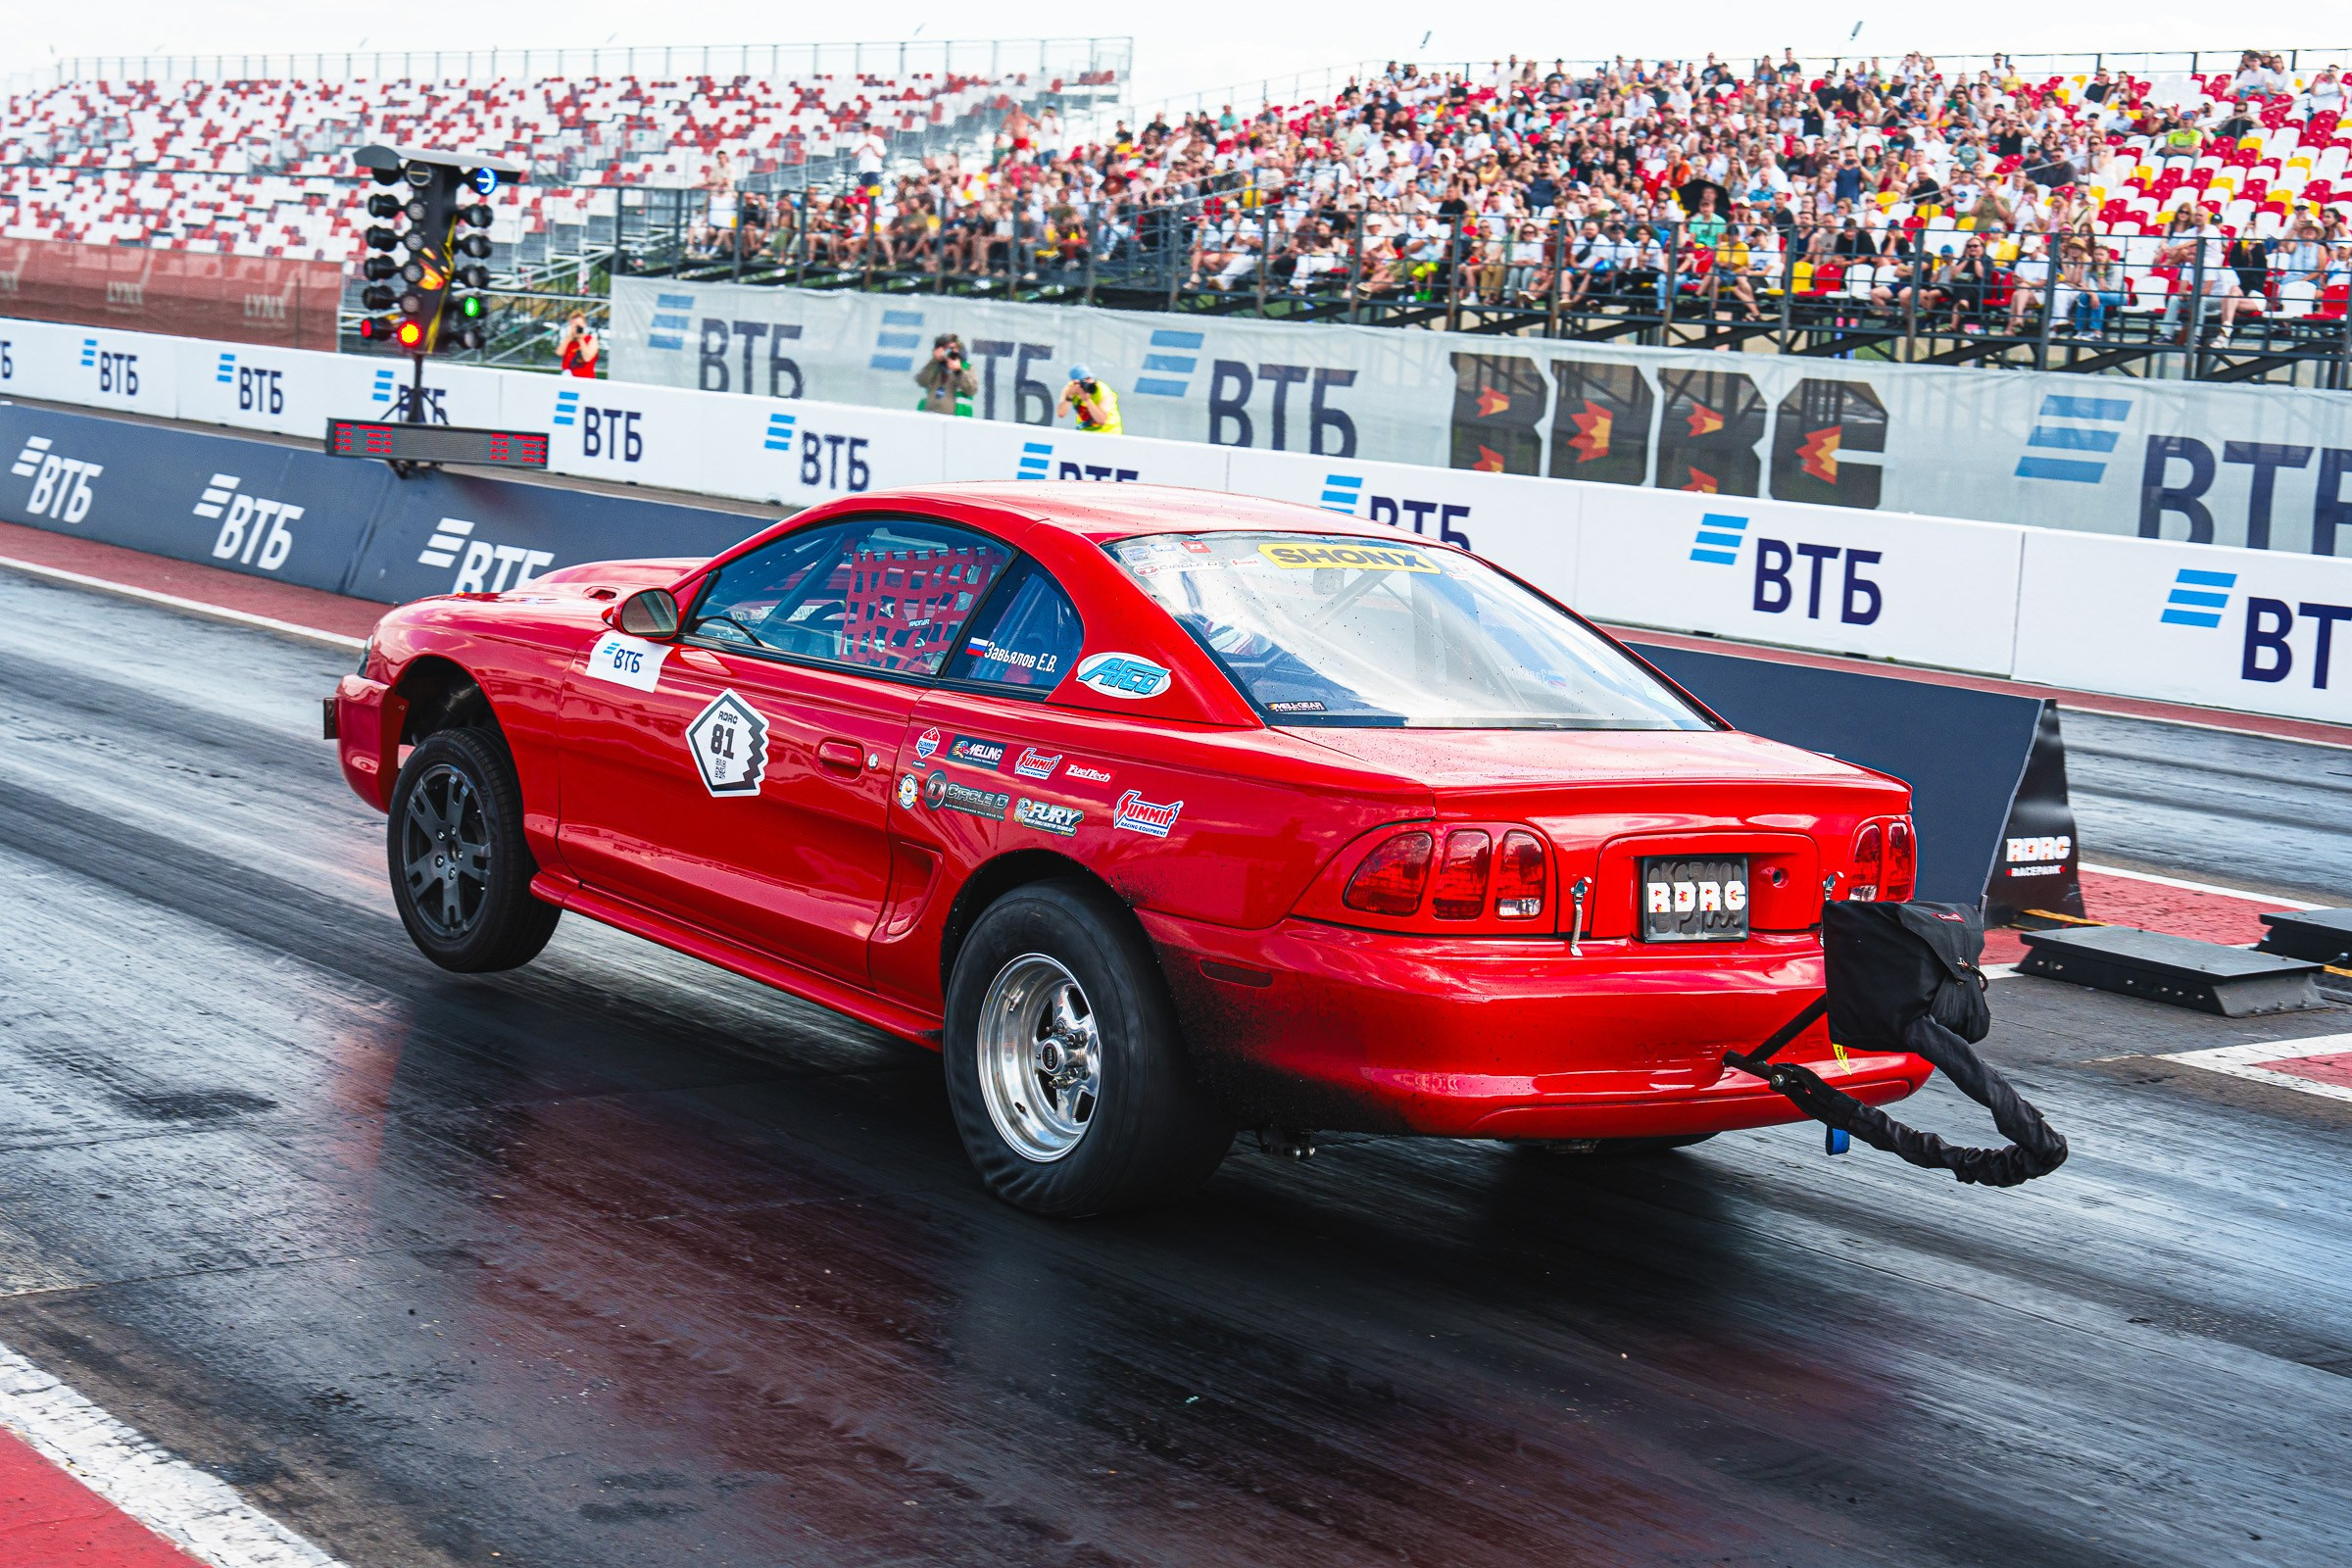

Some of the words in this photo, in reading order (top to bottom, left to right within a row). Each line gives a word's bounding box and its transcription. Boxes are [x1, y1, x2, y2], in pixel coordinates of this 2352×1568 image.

[100, 351, 139, 396] ВТБ
[699, 318, 804, 399] ВТБ
[239, 367, 284, 415] ВТБ
[971, 338, 1054, 427] ТБ
[398, 384, 447, 423] ВБ
[1208, 359, 1358, 459] ВТБ
[584, 407, 643, 463] ВТБ
[800, 429, 870, 492] ВТБ
[26, 454, 104, 524] ВТБ
[213, 493, 306, 570] ВТБ
[1270, 547, 1432, 569] SHONX
[1752, 537, 1884, 626] ВТБ
[612, 648, 644, 674] ВТБ
[984, 641, 1037, 668] Завьялов
[1036, 653, 1057, 673] Е.В.
[2240, 596, 2352, 690] ВТ
[1079, 658, 1171, 696] AFCO
[717, 710, 739, 725] RDRC
[710, 723, 735, 760] 81
[1066, 763, 1111, 782] FuelTech
[946, 783, 993, 808] CIRCLE
[1027, 801, 1084, 826] FURY
[1117, 793, 1175, 826] SUMMIT
[1120, 821, 1139, 830] RACING
[1138, 825, 1167, 836] EQUIPMENT
[2006, 835, 2072, 862] RDRC
[1647, 881, 1746, 913] RDRC
